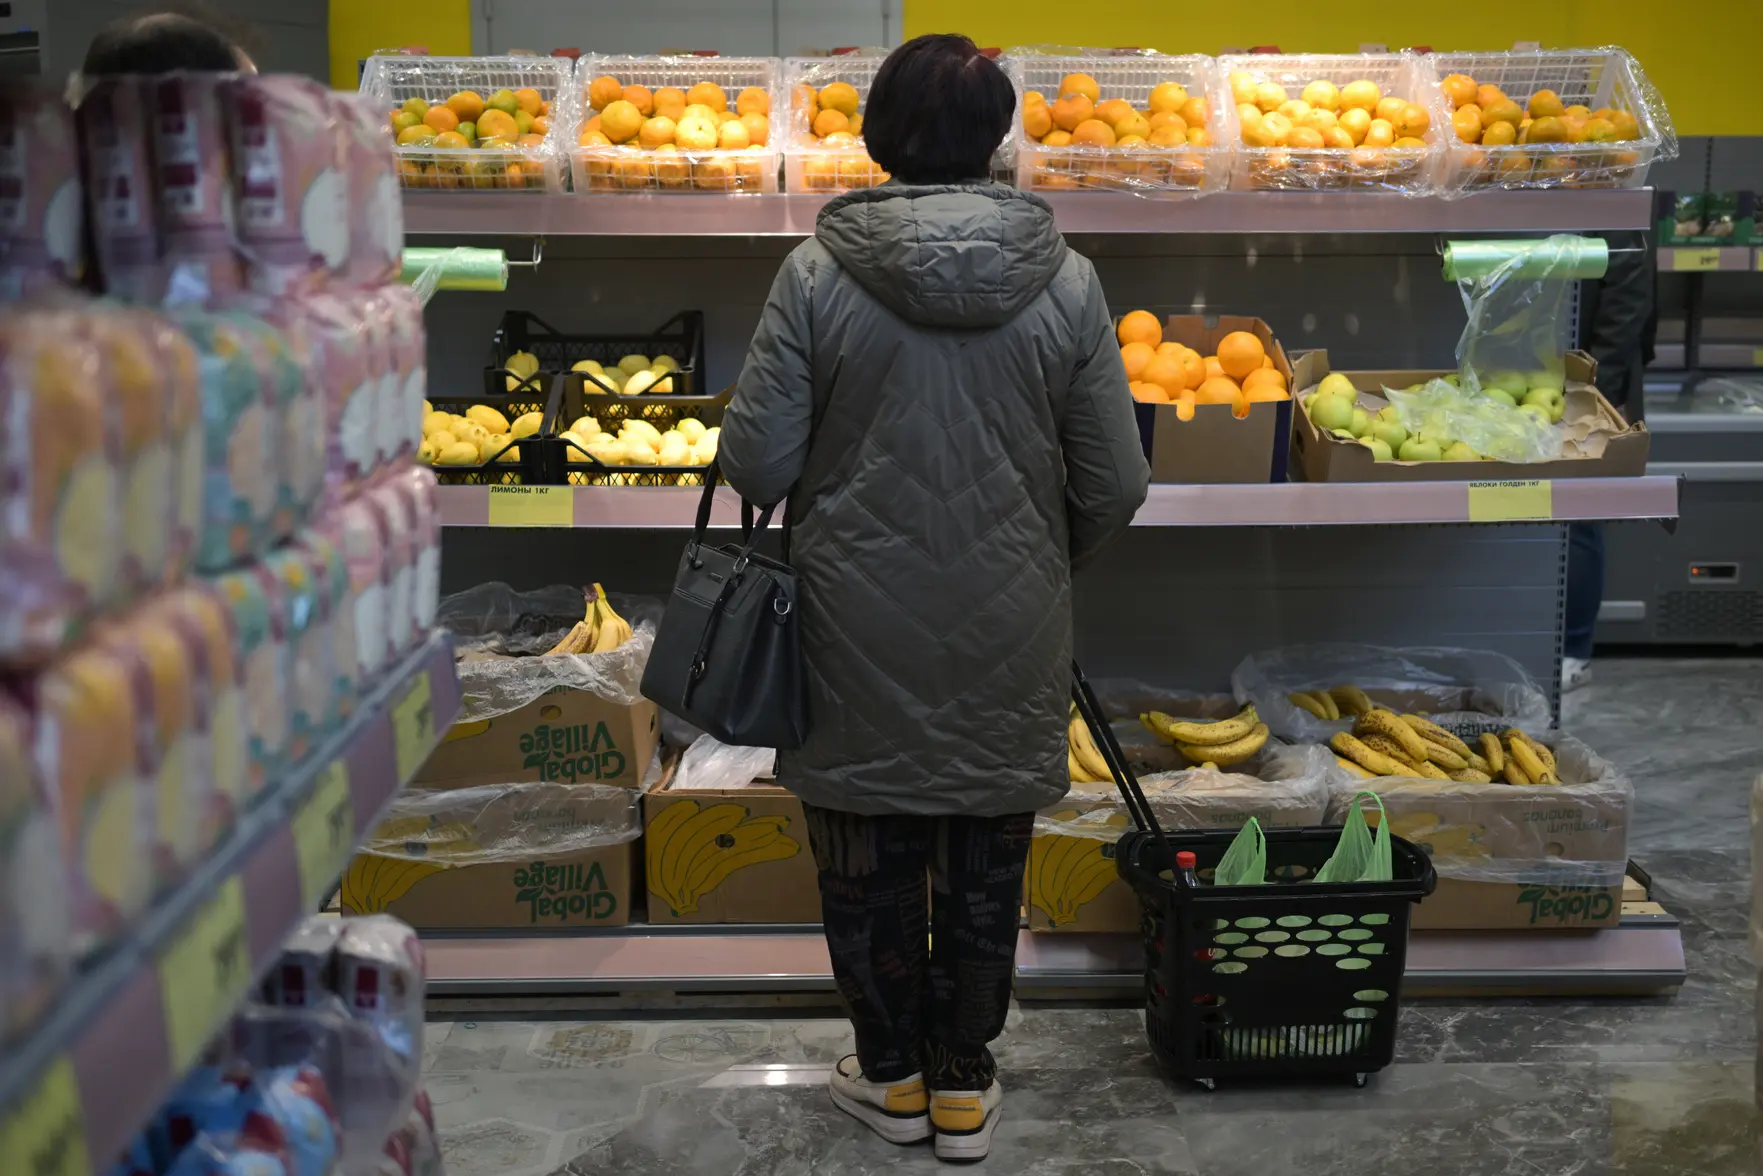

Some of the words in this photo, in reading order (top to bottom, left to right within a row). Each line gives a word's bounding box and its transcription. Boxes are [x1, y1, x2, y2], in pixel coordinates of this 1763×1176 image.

[491, 486, 532, 494] ЛИМОНЫ
[519, 721, 616, 753] Village
[523, 750, 626, 785] Global
[513, 861, 607, 891] Village
[515, 891, 617, 924] Global
[1517, 893, 1614, 924] Global
